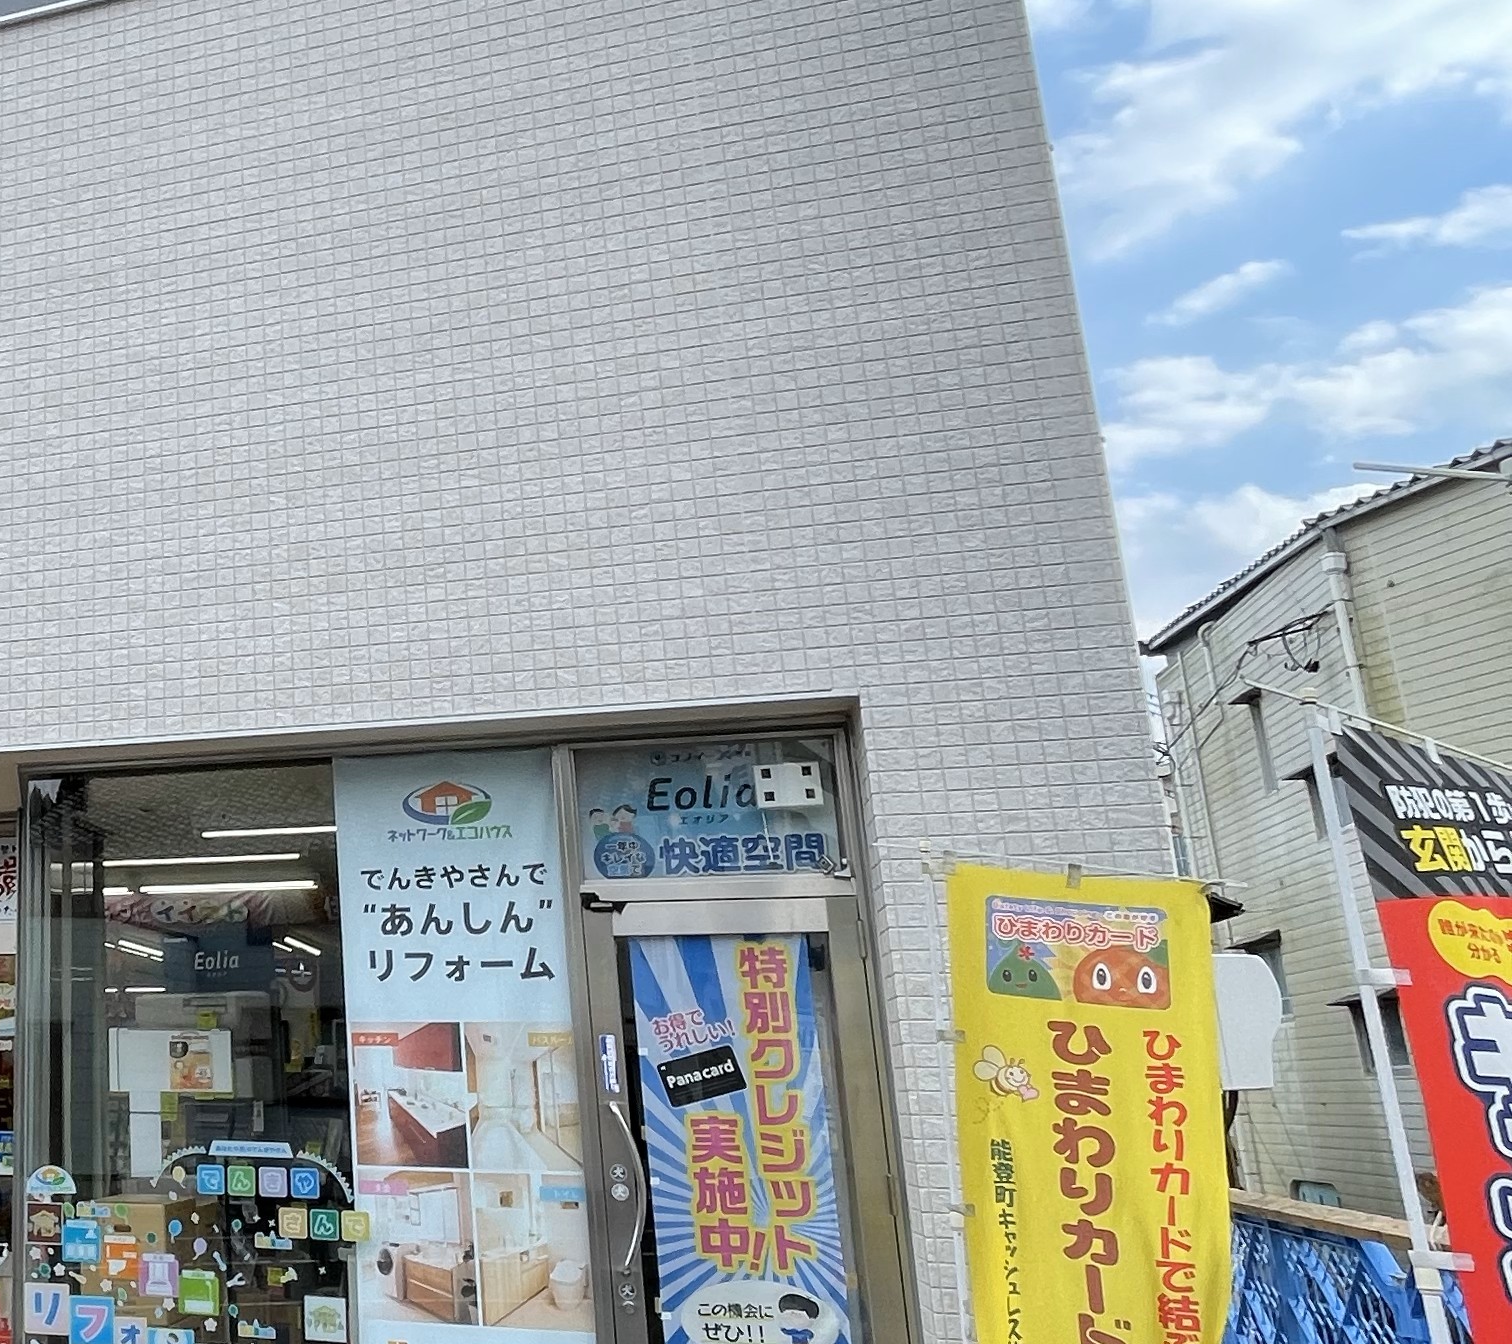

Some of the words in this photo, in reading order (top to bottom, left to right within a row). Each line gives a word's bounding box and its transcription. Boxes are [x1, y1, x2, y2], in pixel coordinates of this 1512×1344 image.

[646, 772, 757, 812] Eolia
[679, 813, 729, 825] エオリア
[659, 833, 825, 874] 快適空間
[1400, 824, 1512, 874] 玄関から
[360, 862, 549, 891] でんきやさんで
[995, 916, 1159, 949] ひまわりカード
[194, 949, 240, 971] Eolia
[368, 947, 556, 982] リフォーム
[652, 1009, 705, 1035] お得で
[358, 1035, 392, 1045] キッチン
[666, 1058, 735, 1089] Panacard
[738, 946, 815, 1272] 特別クレジット
[201, 1167, 316, 1195] でんきや
[689, 1115, 768, 1272] 実施中！
[282, 1211, 366, 1236] さんで
[697, 1302, 774, 1319] この機会に
[702, 1322, 766, 1344] ぜひ！！
